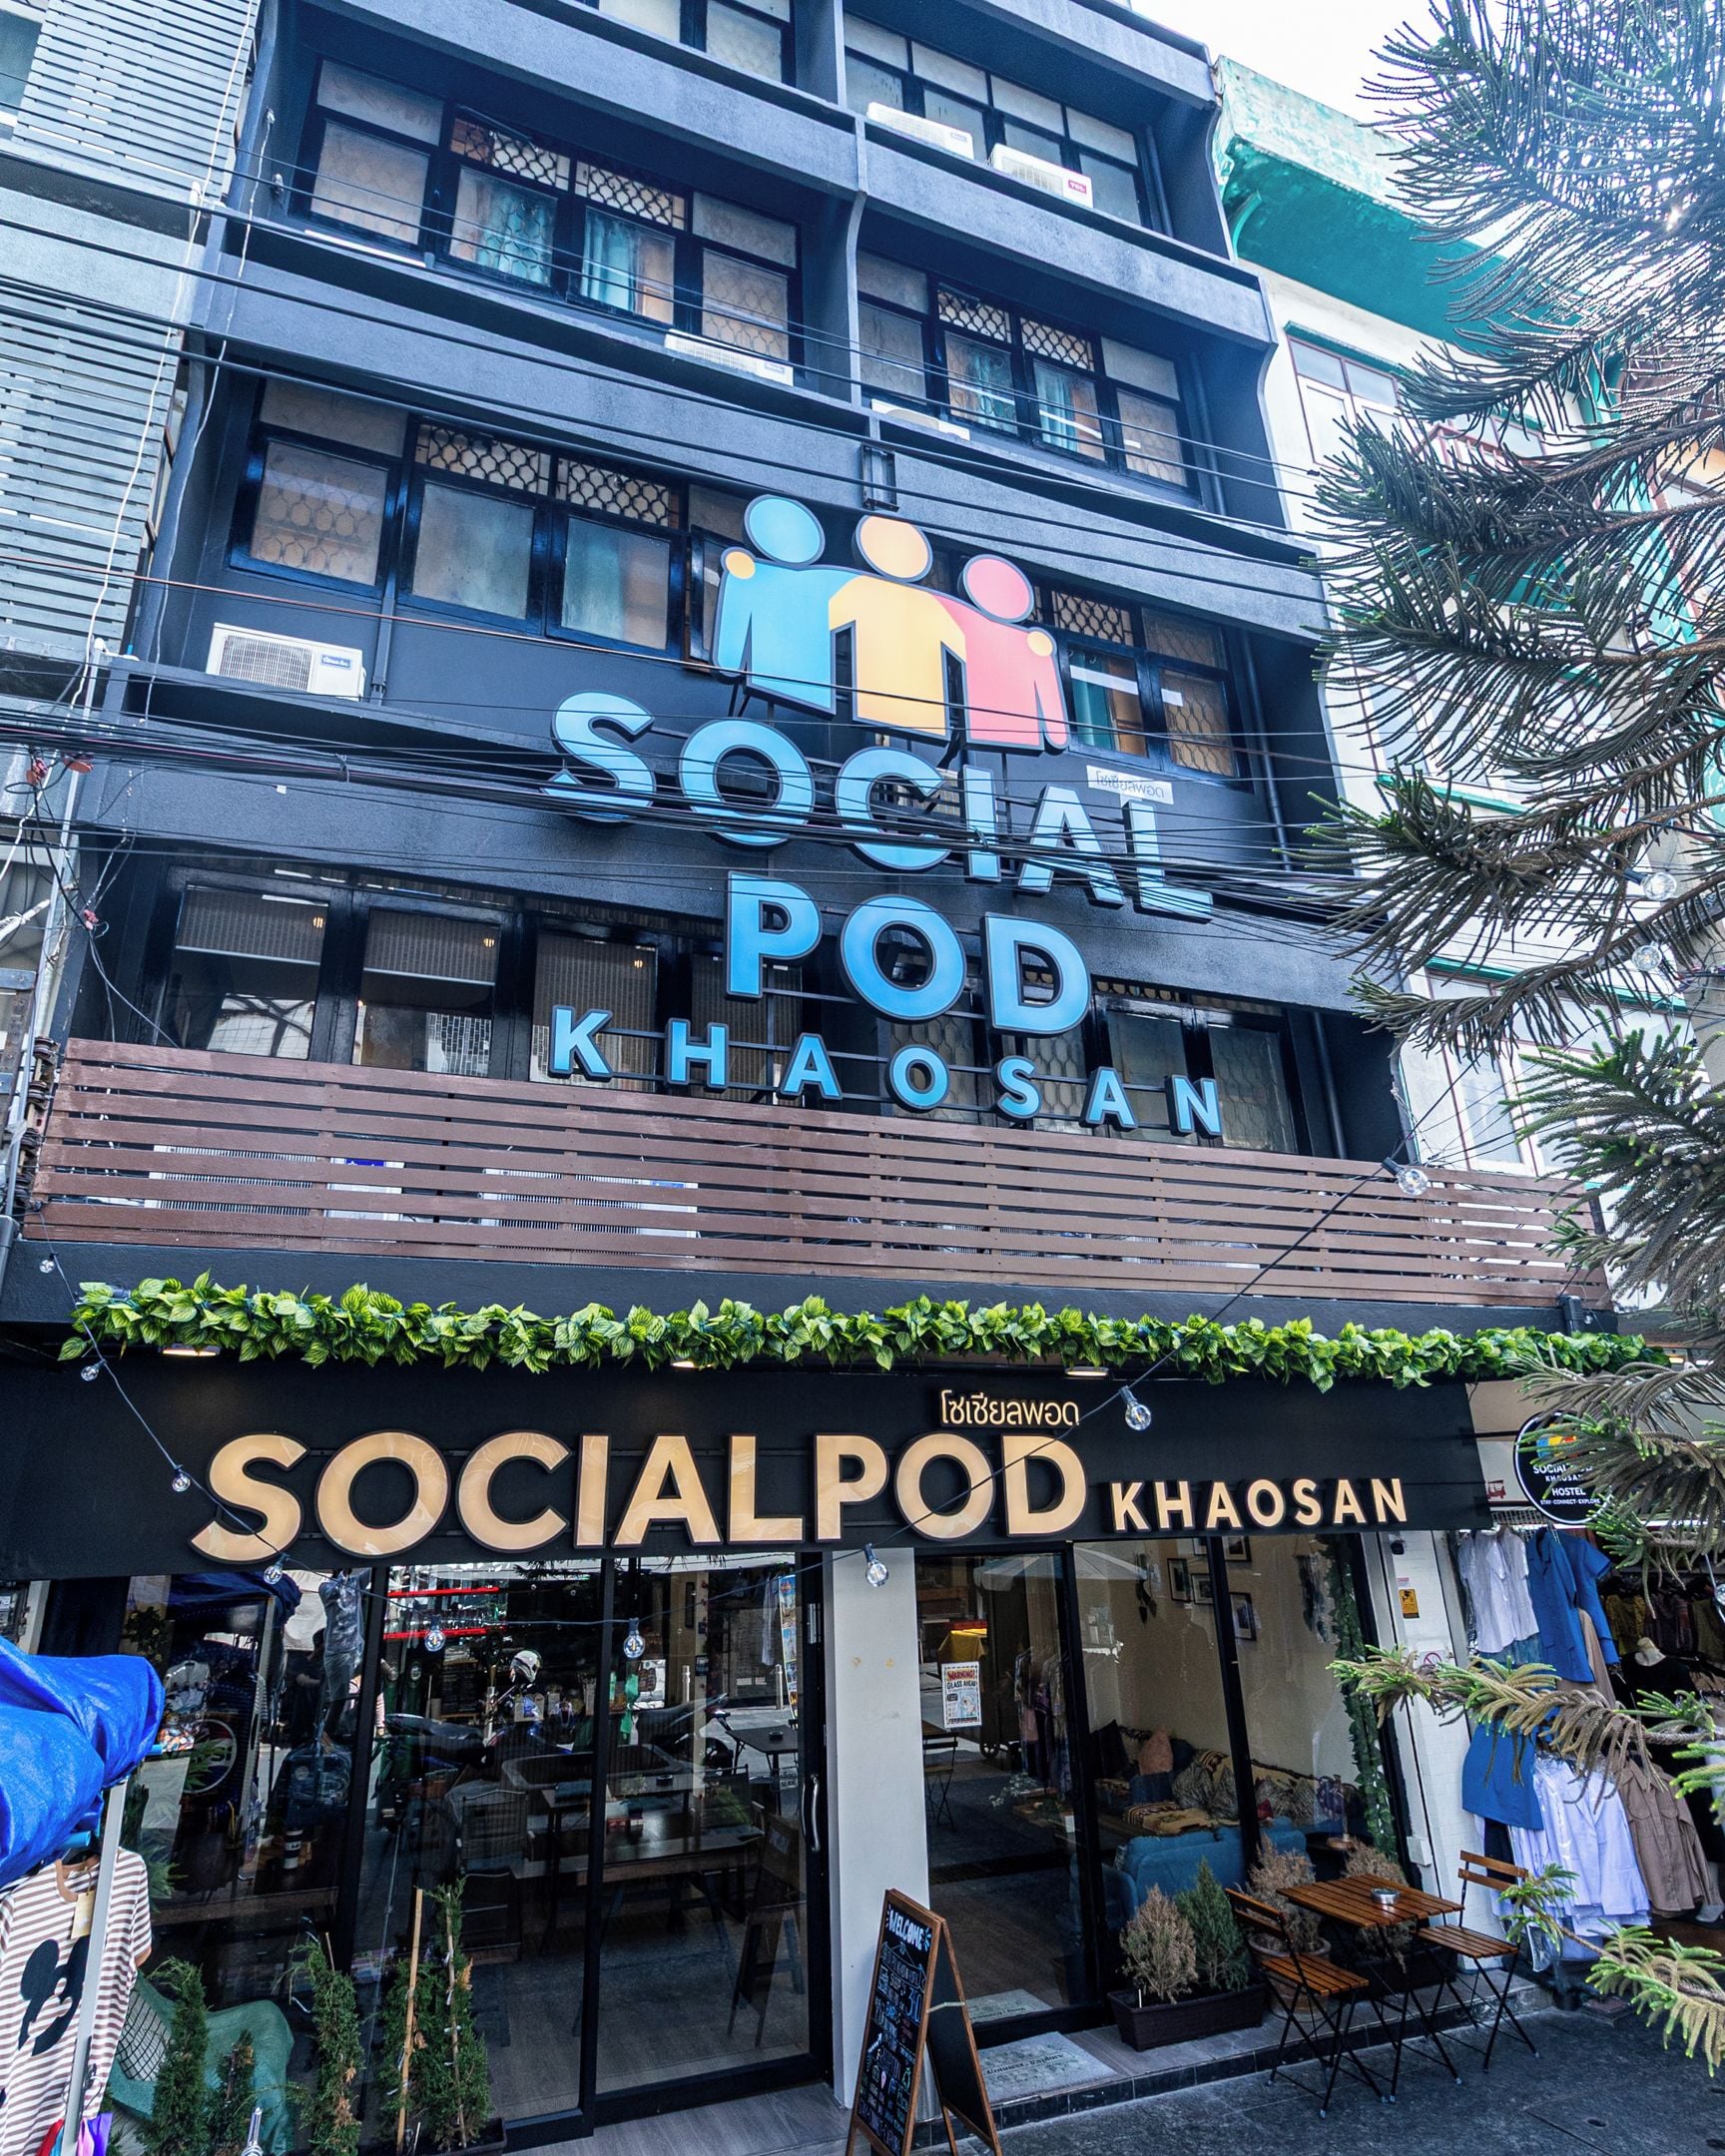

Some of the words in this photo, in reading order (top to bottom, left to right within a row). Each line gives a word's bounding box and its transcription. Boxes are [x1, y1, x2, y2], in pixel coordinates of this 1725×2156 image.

[1069, 181, 1085, 192] TCL
[545, 692, 1213, 922] SOCIAL
[726, 870, 1091, 1036] POD
[549, 1004, 1223, 1137] KHAOSAN
[940, 1388, 1080, 1426] โซเชียลพอด
[1110, 1477, 1409, 1533] KHAOSAN
[1551, 1487, 1586, 1496] HOSTEL
[888, 1909, 924, 1949] WELCOME
